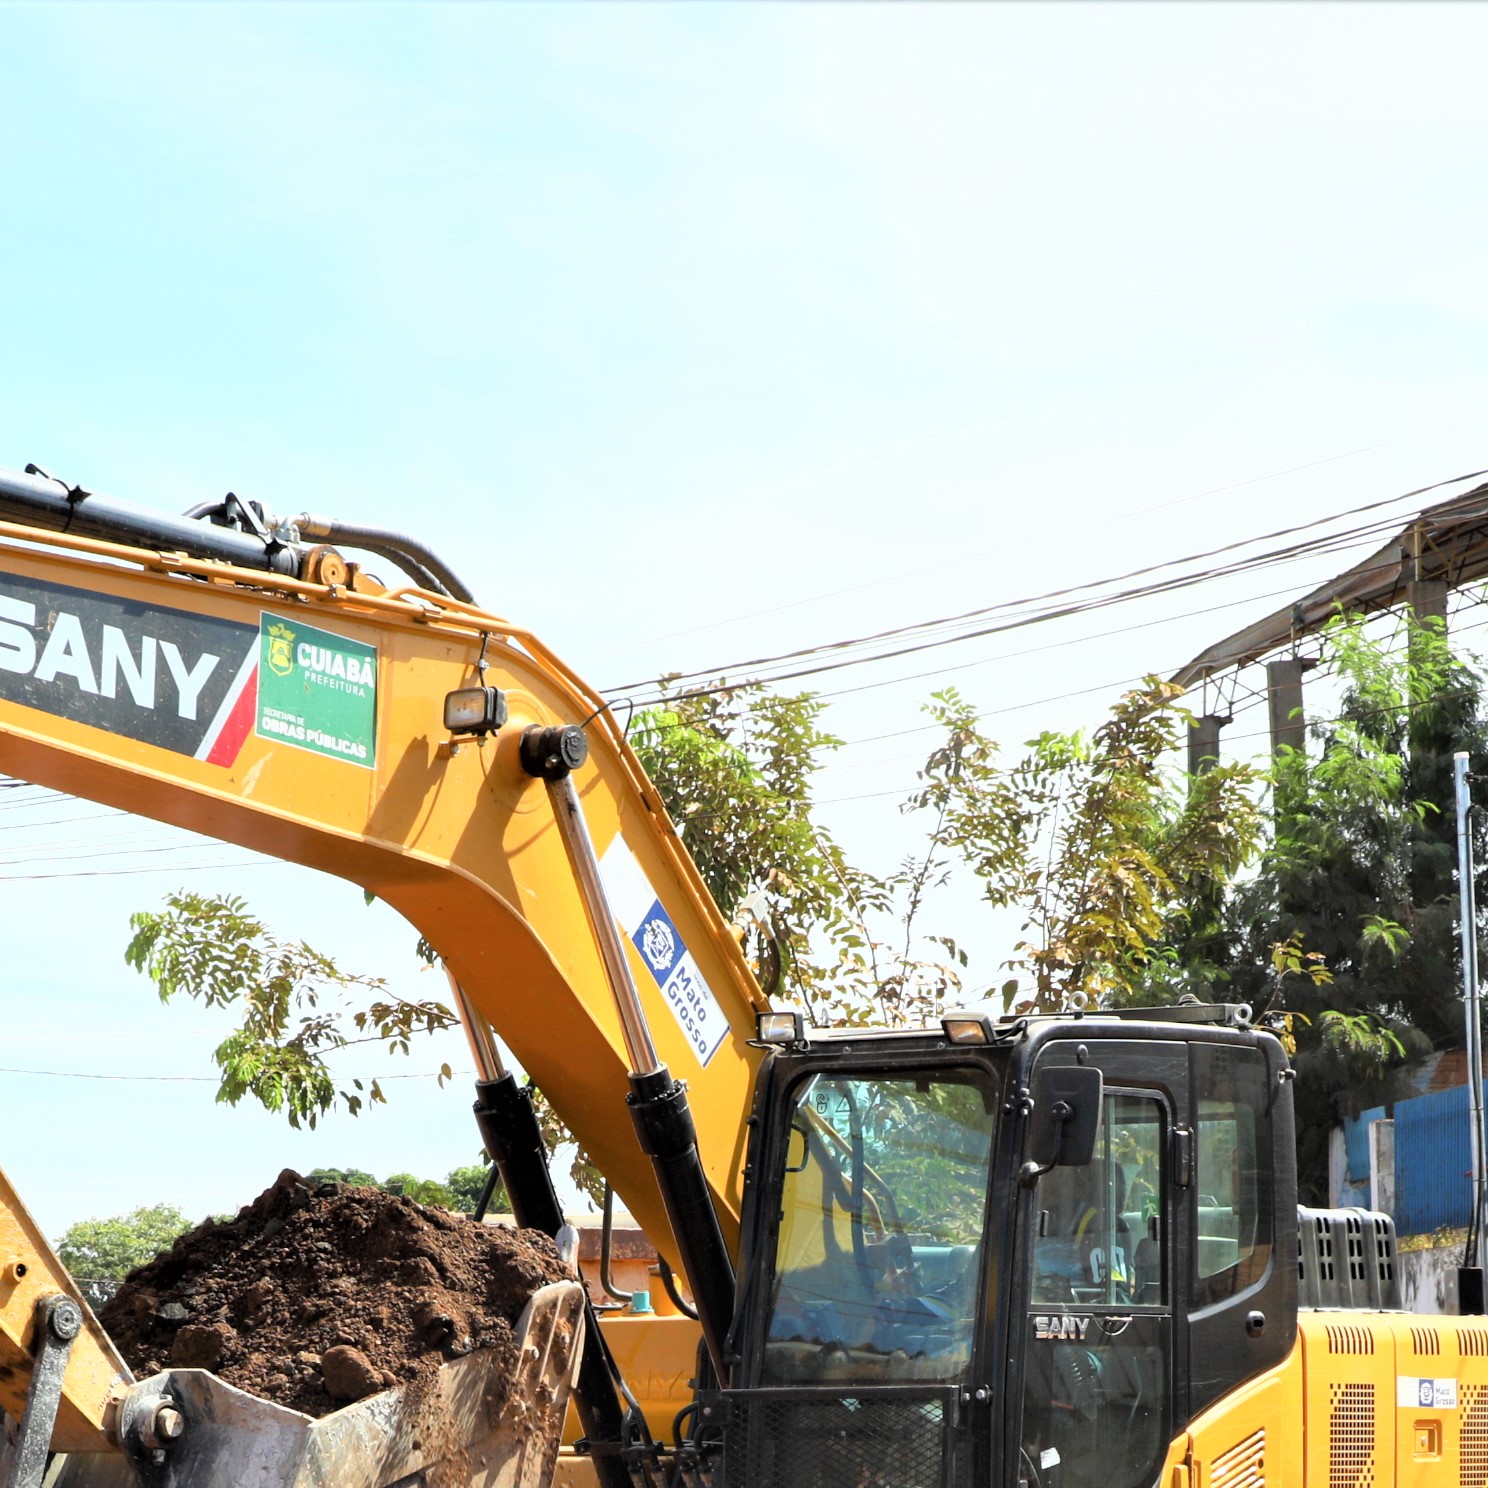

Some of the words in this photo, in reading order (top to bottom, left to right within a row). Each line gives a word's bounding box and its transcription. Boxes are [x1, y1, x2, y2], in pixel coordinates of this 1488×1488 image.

[297, 642, 375, 688] CUIABÁ
[304, 670, 366, 698] PREFEITURA
[262, 716, 305, 741] OBRAS
[306, 729, 367, 759] PÚBLICAS
[263, 707, 297, 724] SECRETARIA
[297, 717, 305, 727] DE
[675, 965, 707, 1022] Mato
[667, 981, 707, 1055] Grosso
[1035, 1316, 1090, 1340] SANY
